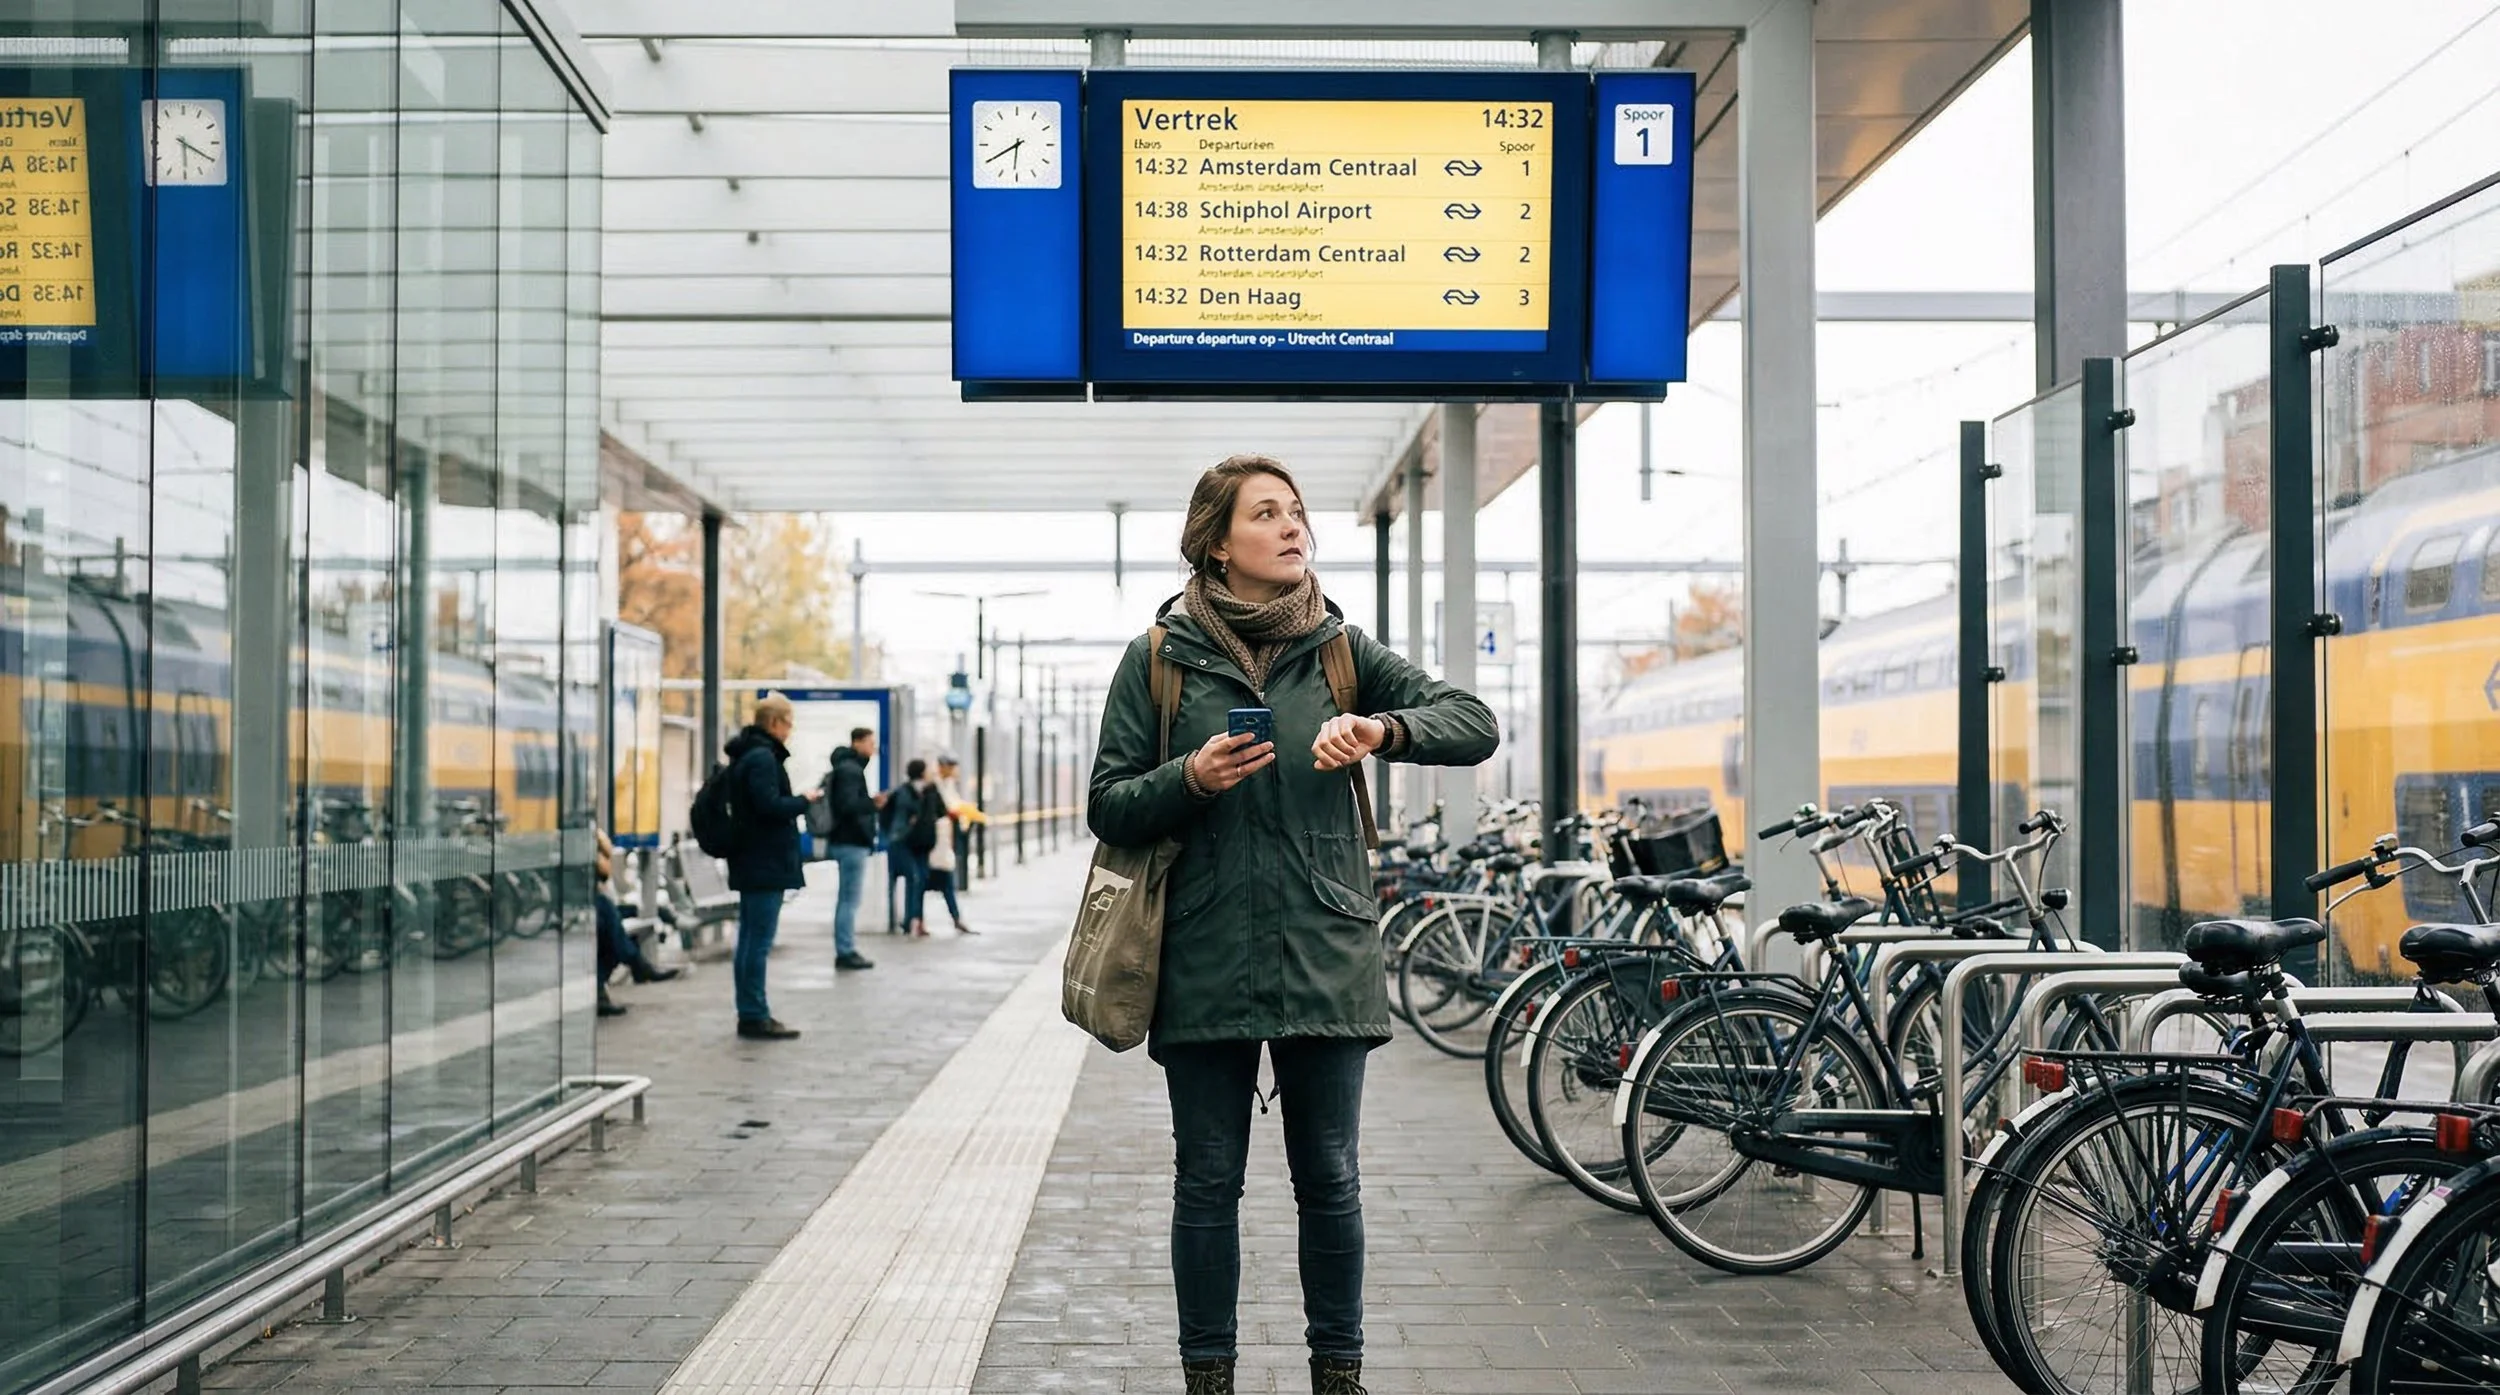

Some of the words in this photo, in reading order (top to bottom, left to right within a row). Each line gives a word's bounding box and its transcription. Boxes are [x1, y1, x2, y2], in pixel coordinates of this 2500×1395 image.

[1135, 106, 1238, 131] Vertrek
[1482, 108, 1544, 129] 14:32
[1623, 108, 1665, 123] Spoor
[1499, 141, 1536, 154] Spoor
[1636, 127, 1649, 157] 1
[1135, 158, 1188, 175] 14:32
[1199, 157, 1321, 176] Amsterdam
[1329, 158, 1417, 176] Centraal
[1521, 160, 1530, 177] 1
[1135, 201, 1188, 219] 14:38
[1200, 200, 1289, 224] Schiphol
[1296, 200, 1372, 224] Airport
[1520, 203, 1532, 220] 2
[1135, 244, 1188, 262] 14:32
[1200, 243, 1311, 263] Rotterdam
[1318, 244, 1405, 263] Centraal
[1519, 246, 1531, 263] 2
[1134, 287, 1188, 305] 14:32
[1199, 287, 1240, 305] Den
[1248, 287, 1301, 311] Haag
[1519, 289, 1530, 306] 3
[1133, 332, 1194, 347] Departure
[1259, 335, 1276, 347] op
[1287, 332, 1337, 345] Utrecht
[1338, 332, 1394, 345] Centraal
[1478, 630, 1496, 656] 4
